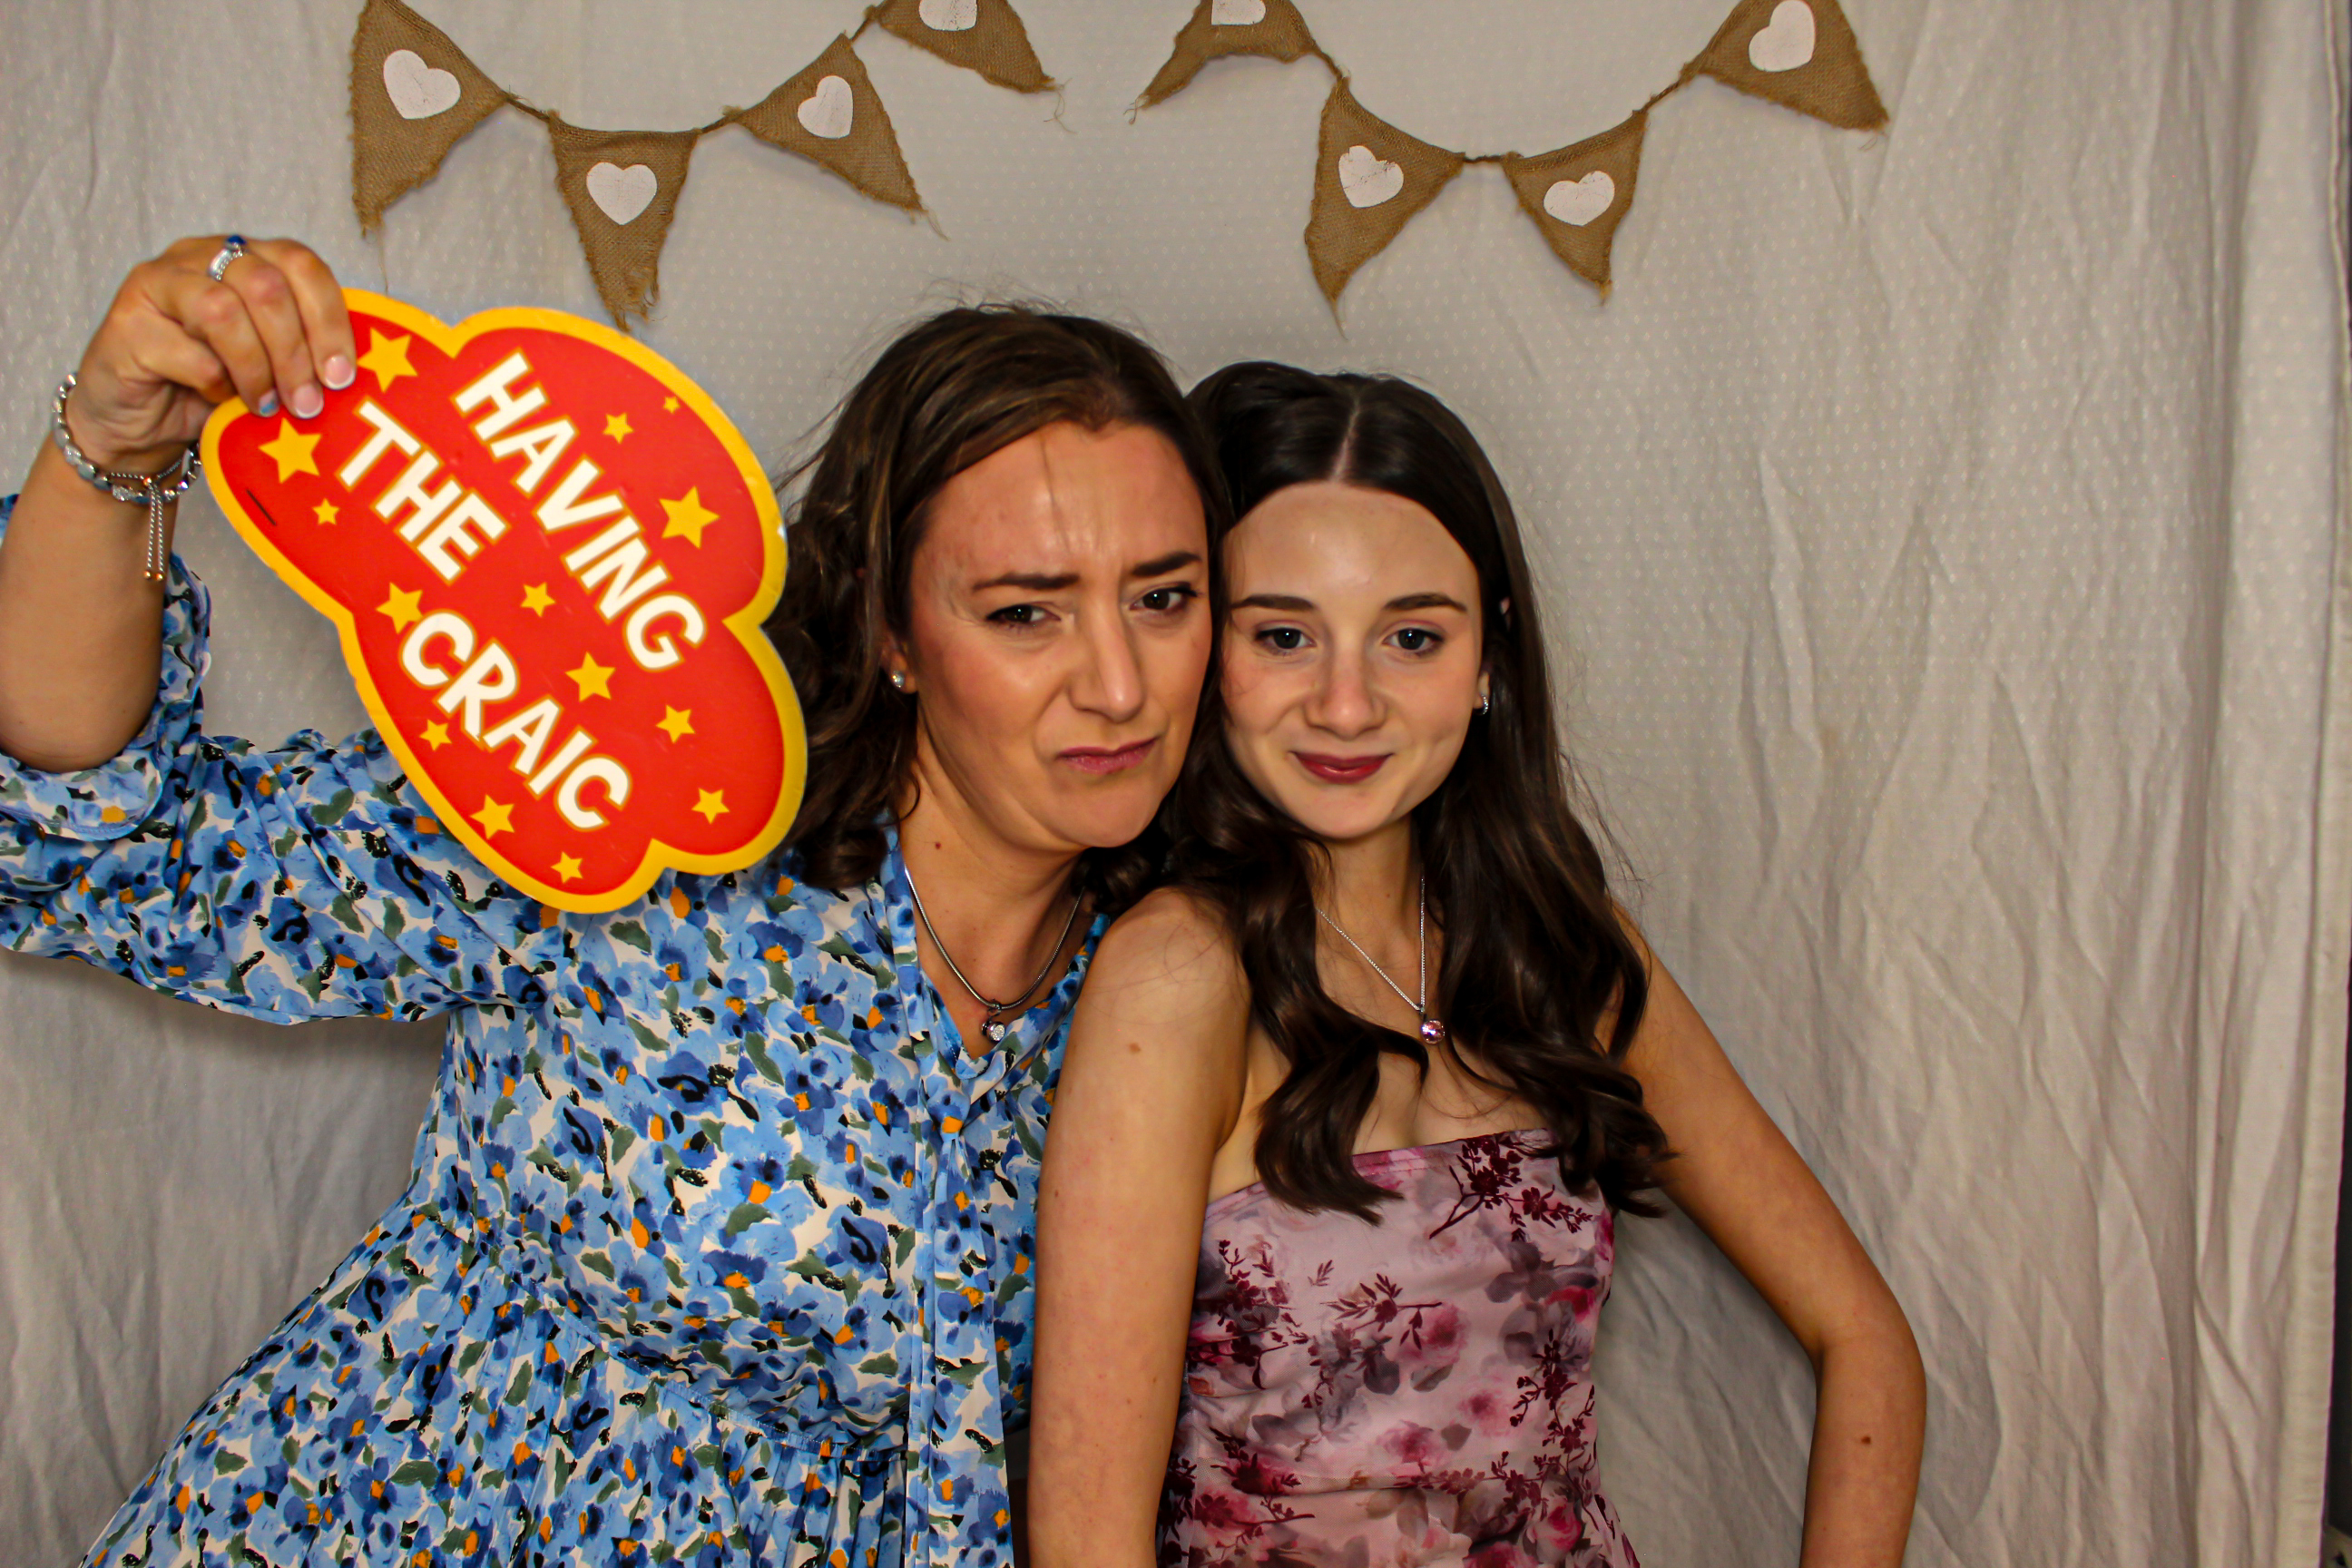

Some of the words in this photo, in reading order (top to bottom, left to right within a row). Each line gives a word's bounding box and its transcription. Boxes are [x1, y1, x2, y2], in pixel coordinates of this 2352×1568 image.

[338, 401, 507, 581] THE
[455, 352, 705, 670] HAVING
[402, 612, 630, 829] CRAIC
